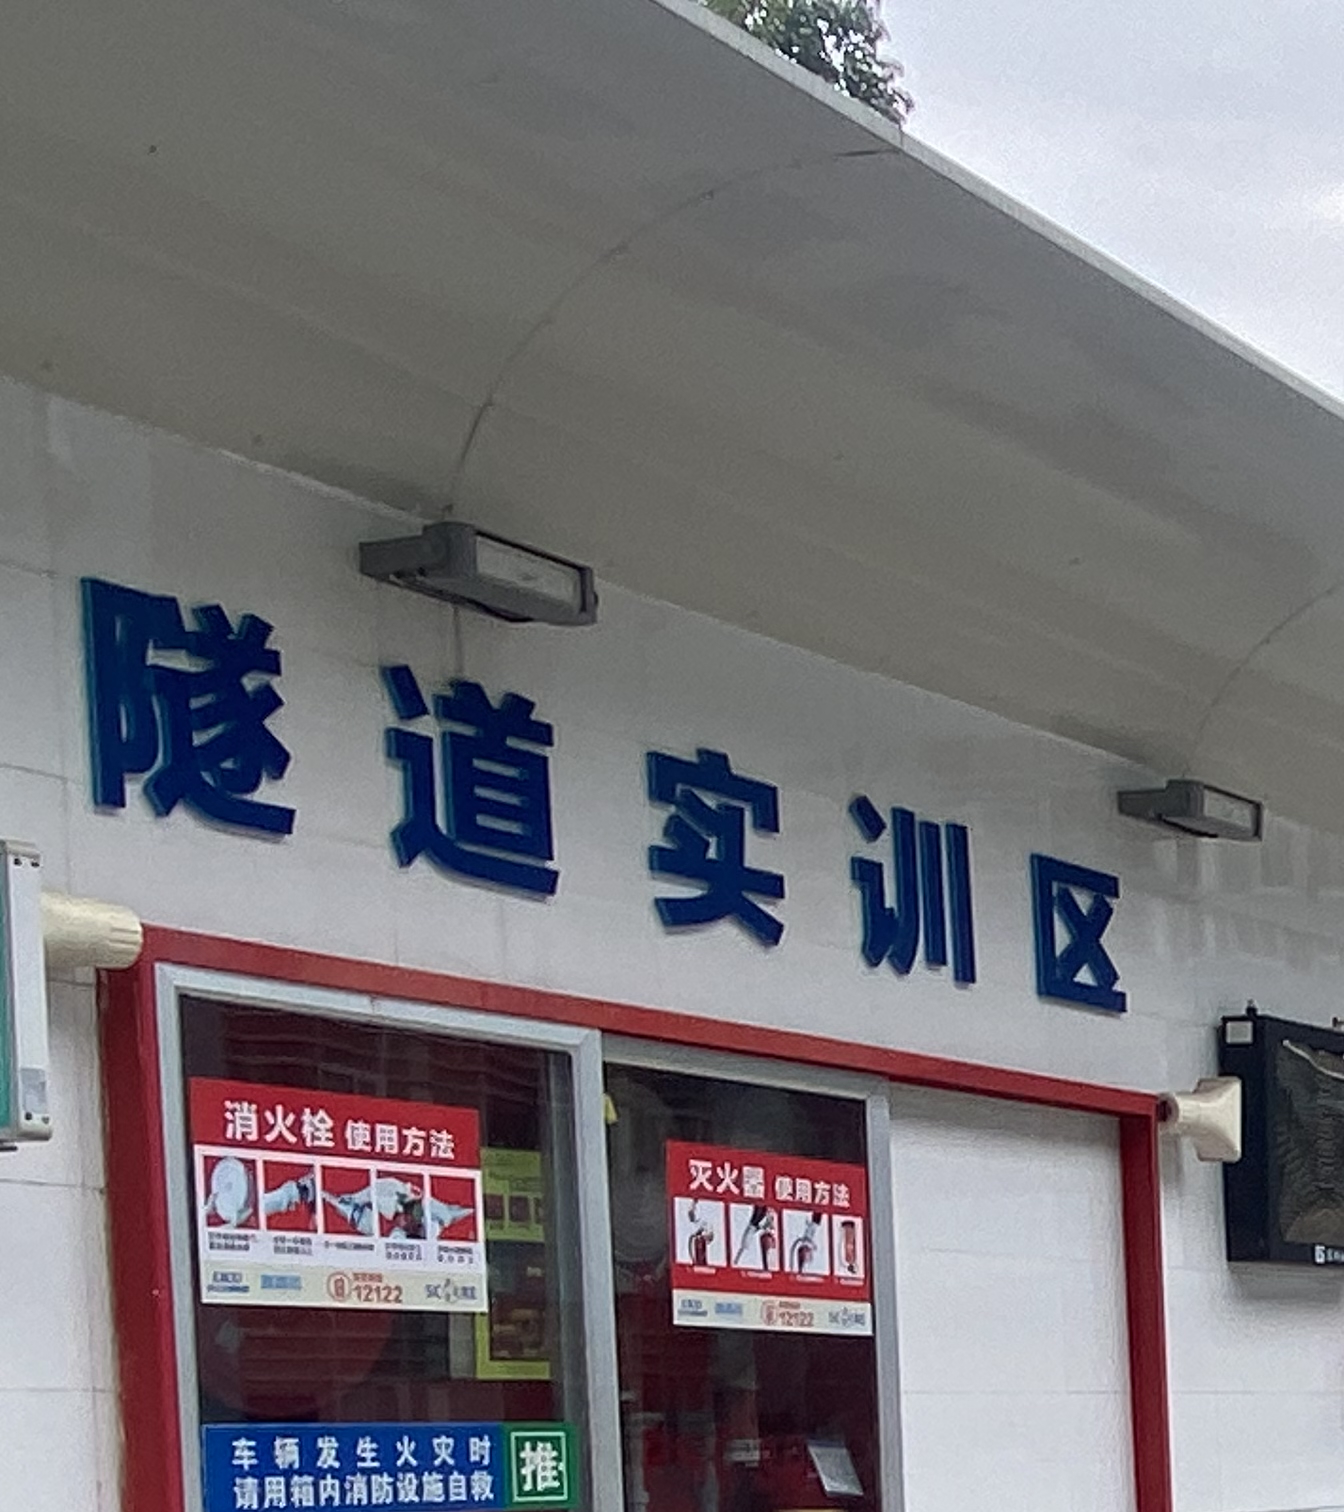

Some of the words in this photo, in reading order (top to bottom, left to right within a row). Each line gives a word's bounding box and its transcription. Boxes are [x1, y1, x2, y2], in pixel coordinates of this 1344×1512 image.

[80, 576, 1128, 1014] 隧道实训区
[224, 1099, 335, 1150] 消火栓
[345, 1119, 456, 1160] 使用方法
[688, 1158, 766, 1200] 灭火器
[353, 1284, 403, 1304] 12122
[231, 1435, 493, 1472] 车辆发生火灾时
[518, 1440, 564, 1492] 推
[234, 1470, 495, 1511] 请用箱内消防设施自救
